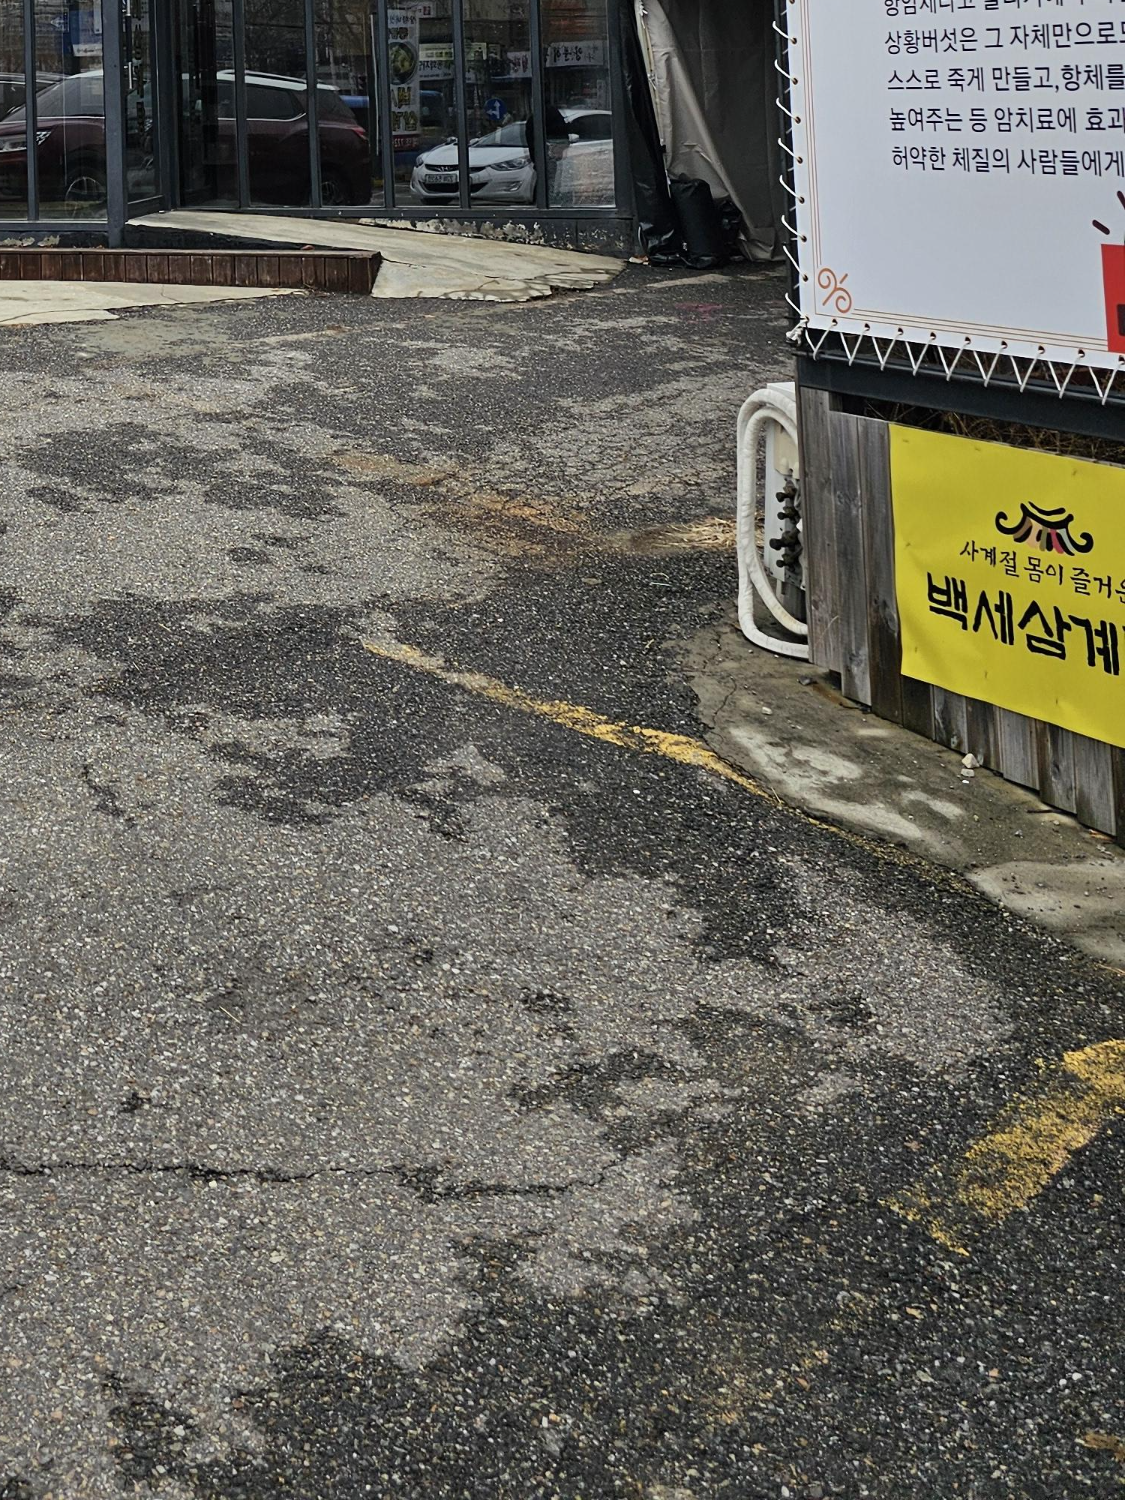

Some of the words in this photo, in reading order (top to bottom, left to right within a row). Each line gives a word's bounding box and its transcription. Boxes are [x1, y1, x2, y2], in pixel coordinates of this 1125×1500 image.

[885, 27, 978, 54] 상황버섯은
[984, 28, 1004, 48] 그
[887, 69, 942, 90] 스스로
[947, 66, 985, 92] 죽게
[889, 107, 963, 131] 높여주는
[969, 107, 987, 133] 등
[994, 106, 1076, 134] 암치료에
[892, 146, 946, 171] 허약한
[952, 147, 1010, 174] 체질의
[1017, 148, 1125, 178] 사람들에게
[959, 539, 1020, 578] 사계절
[1024, 555, 1064, 586] 몸이
[926, 571, 1125, 676] 백세삼계
